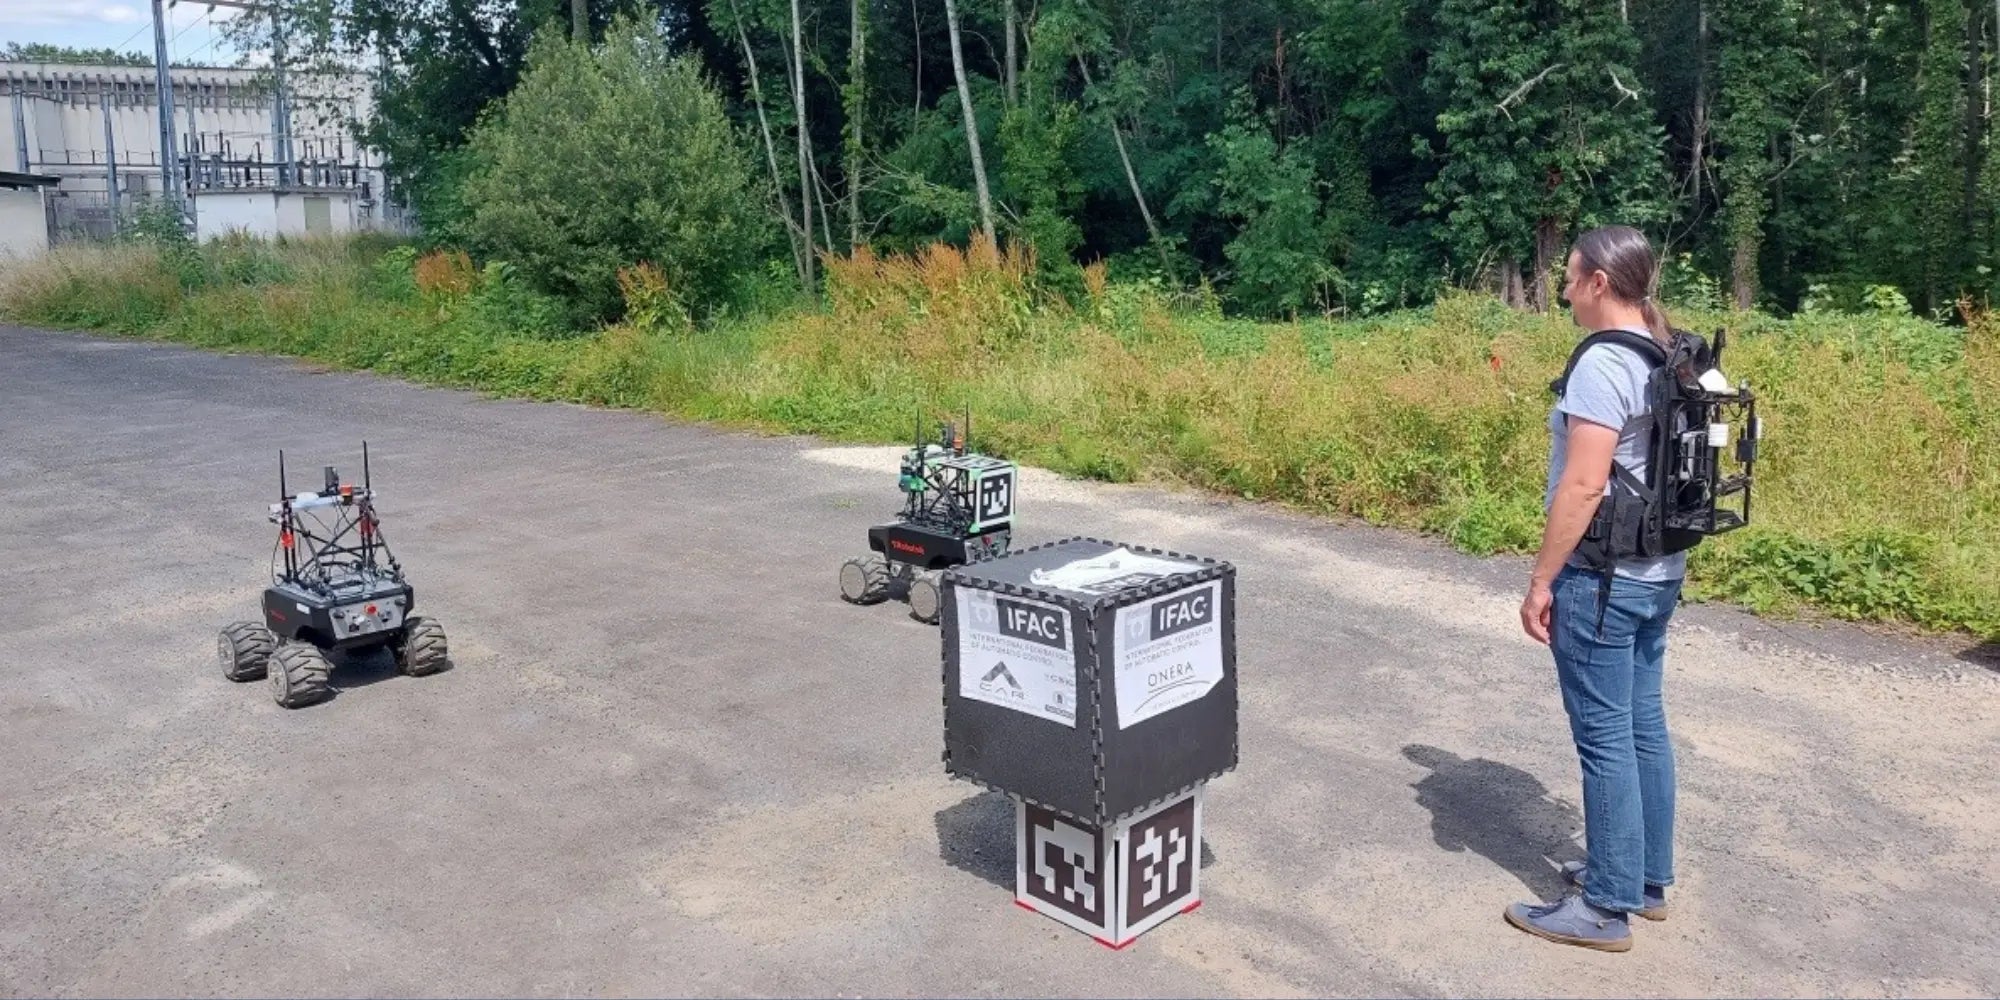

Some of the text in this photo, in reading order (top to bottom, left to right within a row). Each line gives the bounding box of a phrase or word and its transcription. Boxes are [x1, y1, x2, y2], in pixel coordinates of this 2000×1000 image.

[1006, 607, 1058, 640] IFAC
[1160, 596, 1205, 630] IFAC
[1148, 661, 1194, 687] ONERA
